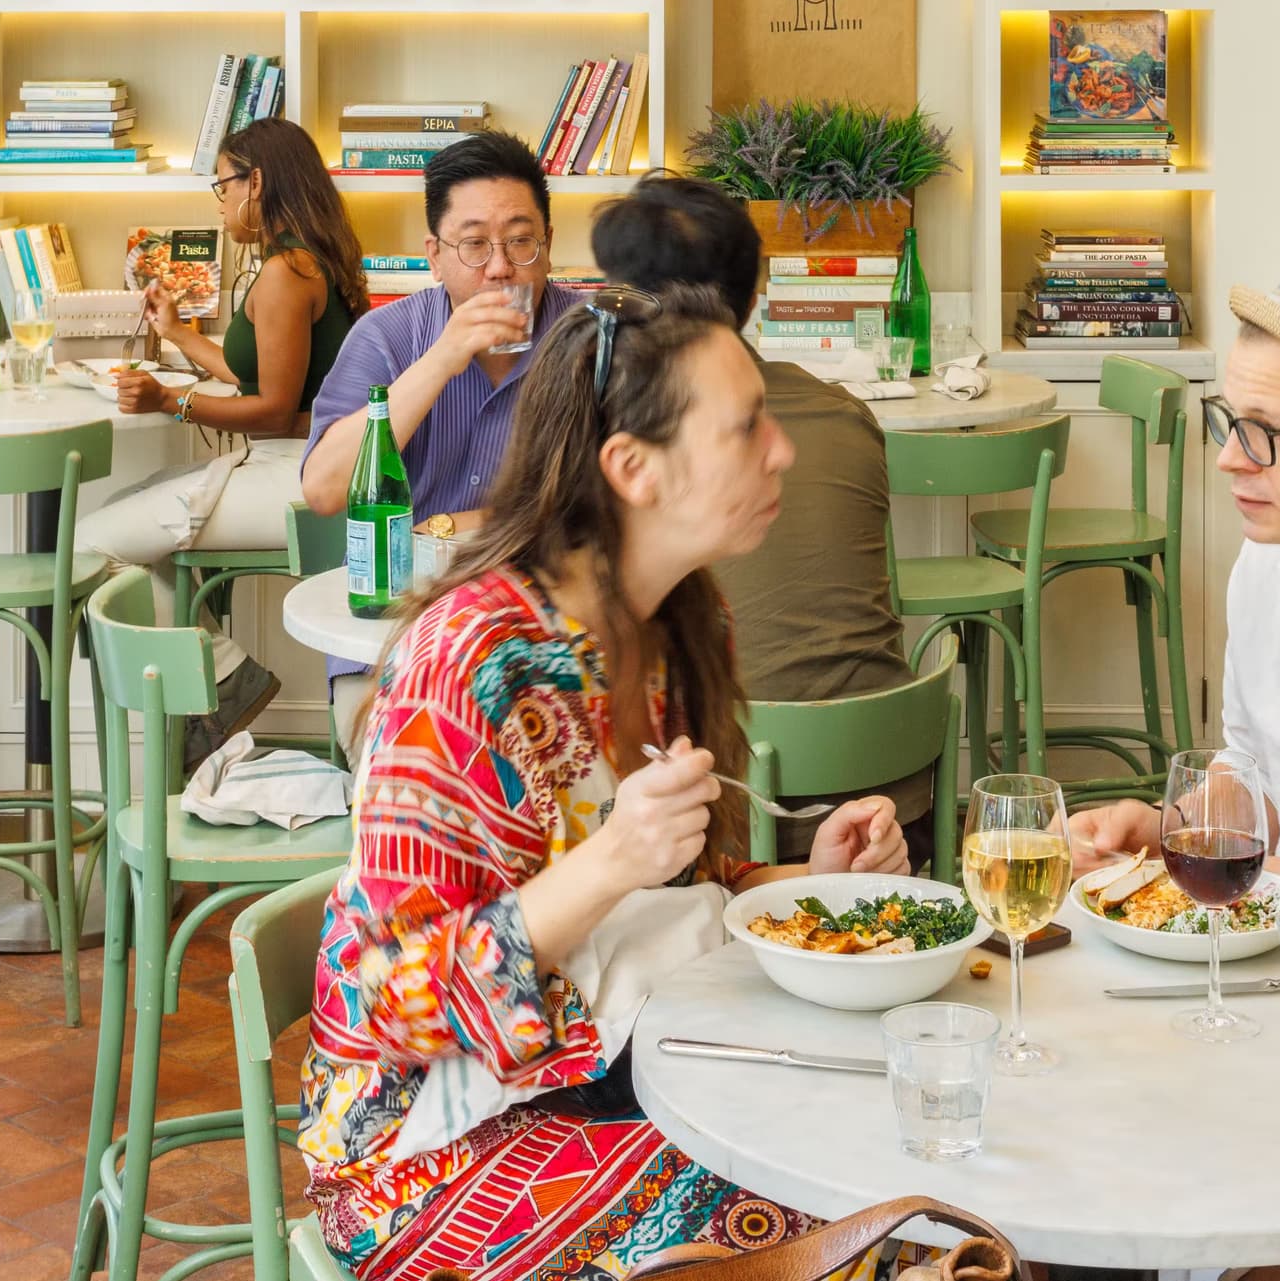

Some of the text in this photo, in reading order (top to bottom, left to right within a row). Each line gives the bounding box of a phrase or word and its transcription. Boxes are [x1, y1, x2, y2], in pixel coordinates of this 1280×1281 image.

[424, 118, 455, 130] SEPIA
[388, 154, 425, 165] PASTA
[179, 244, 209, 255] Pasta
[370, 257, 408, 269] Italian
[1058, 270, 1086, 278] PASTA
[806, 287, 851, 297] ITALIAN
[1102, 292, 1132, 300] COOKING
[778, 324, 849, 333] NEW FEAST
